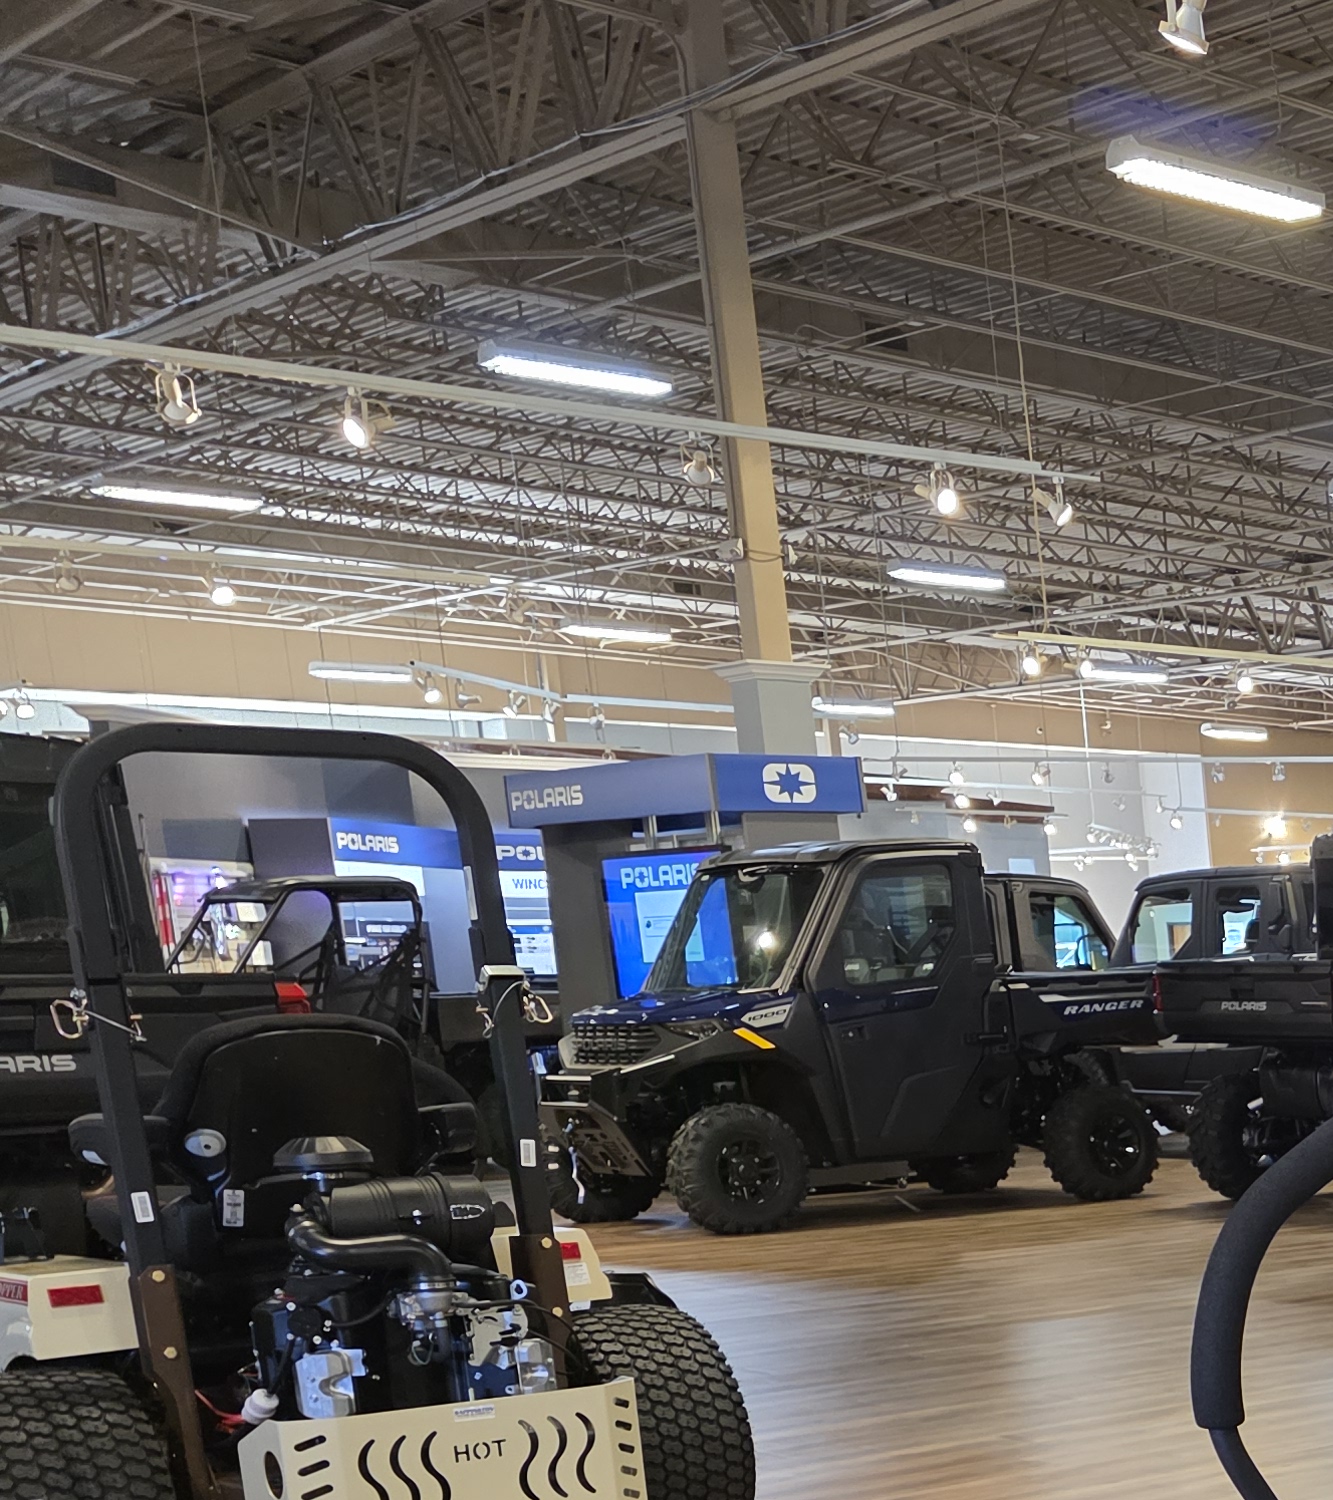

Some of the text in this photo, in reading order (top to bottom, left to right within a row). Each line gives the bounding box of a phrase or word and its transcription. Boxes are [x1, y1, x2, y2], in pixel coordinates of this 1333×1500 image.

[511, 784, 584, 811] POLARIS
[335, 831, 400, 854] POLARIS
[496, 845, 545, 861] POL
[511, 878, 547, 890] WINC
[747, 1008, 787, 1022] 1000
[1063, 999, 1145, 1016] RANGER
[1220, 1001, 1268, 1012] POLARIS
[0, 1054, 77, 1073] ARIS
[453, 1438, 507, 1464] HOT
